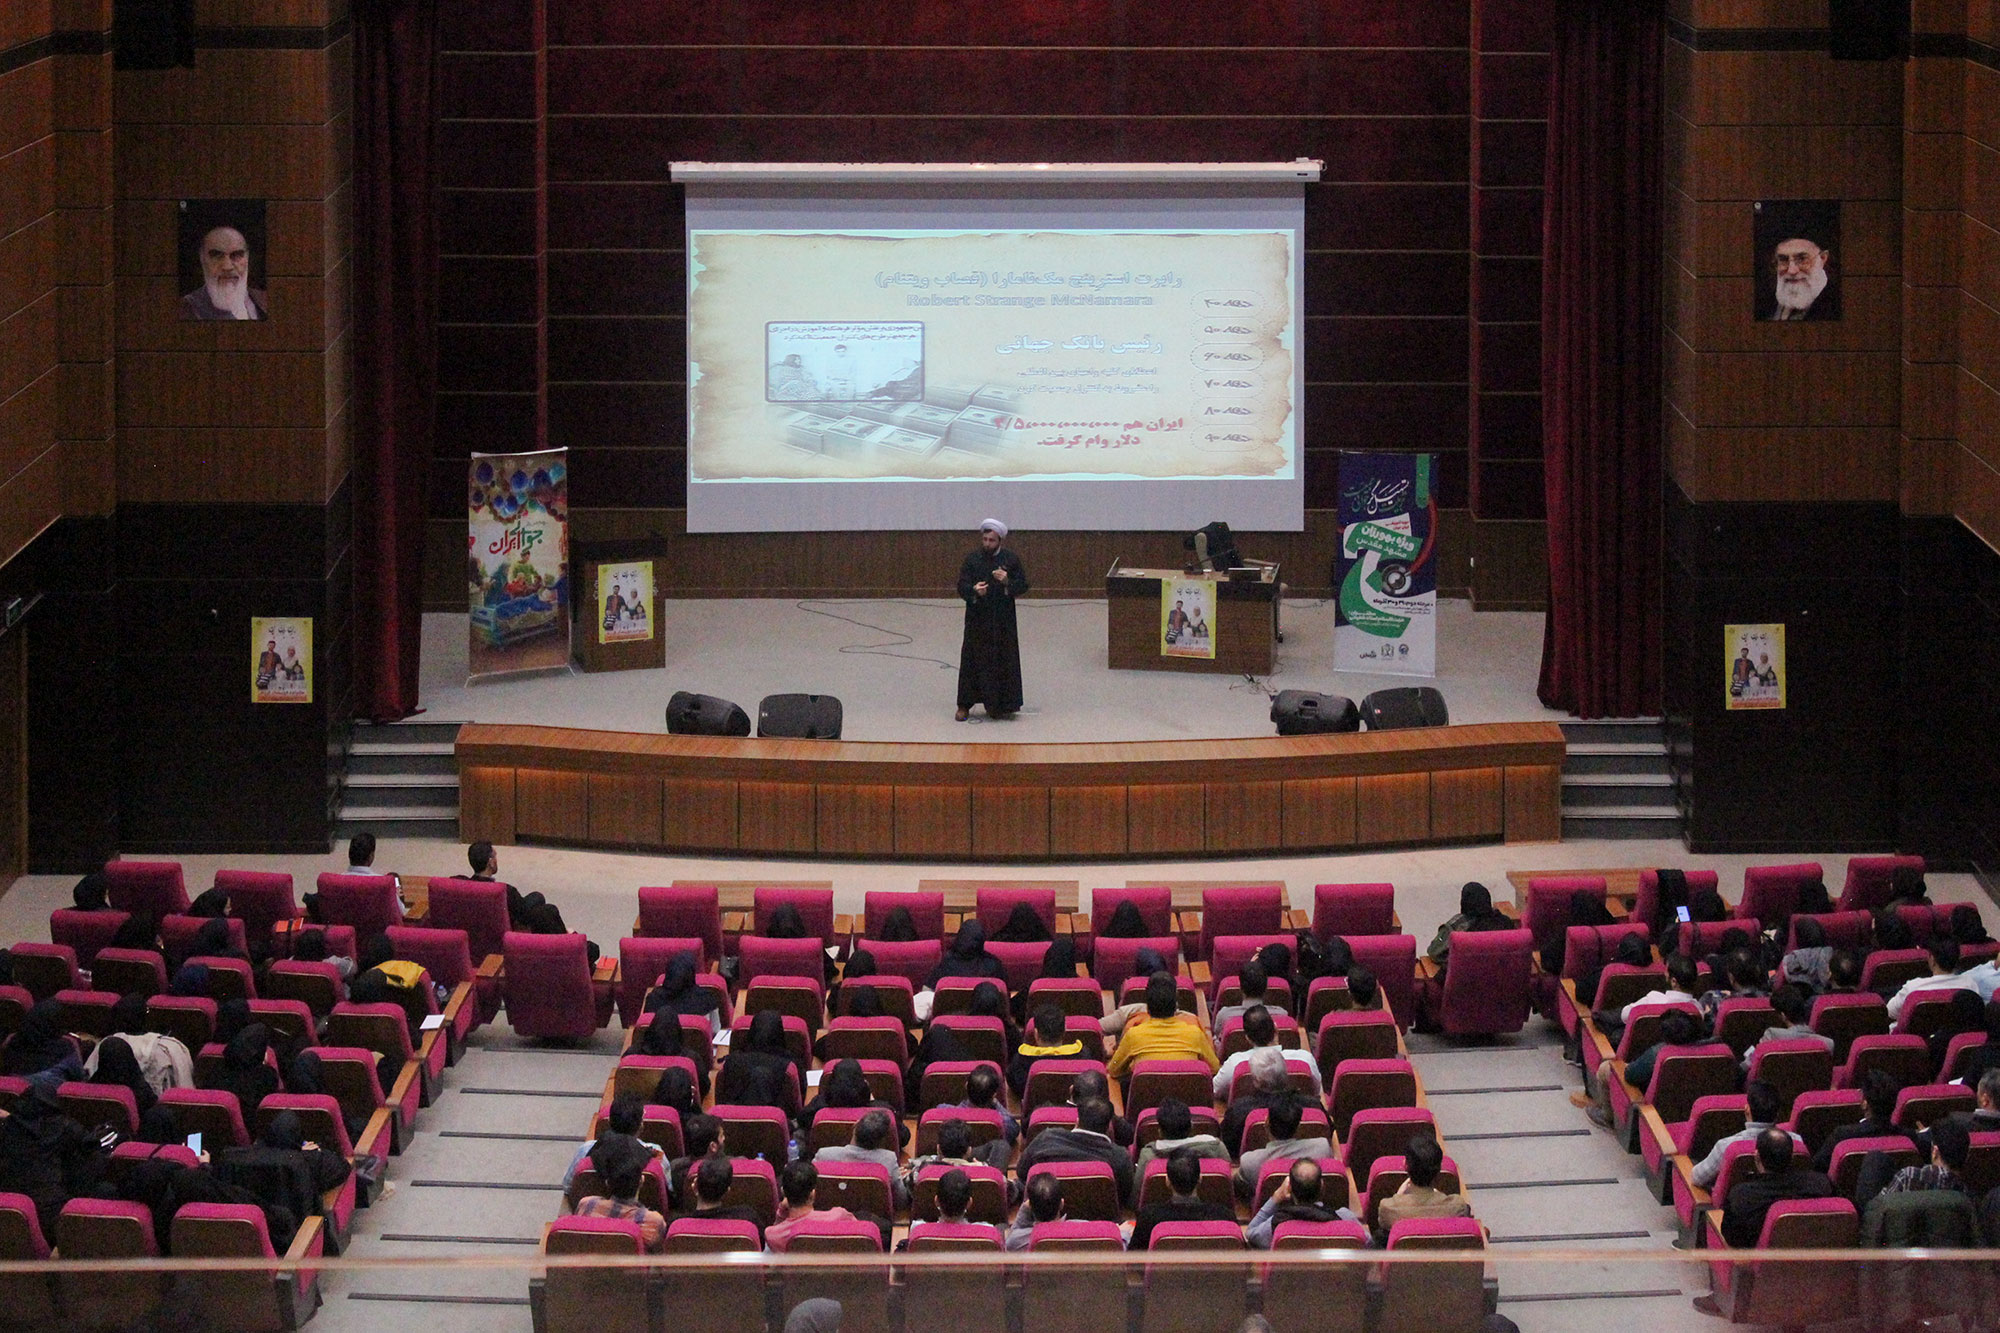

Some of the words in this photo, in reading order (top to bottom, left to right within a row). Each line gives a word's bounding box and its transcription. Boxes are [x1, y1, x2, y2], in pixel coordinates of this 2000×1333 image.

[906, 294, 970, 306] Robert
[974, 294, 1046, 308] Strange
[1051, 294, 1153, 306] McNamara
[995, 334, 1055, 355] جهانی
[1060, 334, 1105, 353] بانک
[1110, 333, 1163, 354] رئیس
[1123, 420, 1144, 431] هم
[1145, 417, 1183, 432] ایران
[1085, 434, 1109, 449] وام
[1112, 434, 1141, 449] دلار
[489, 529, 520, 556] ایران
[1356, 537, 1383, 550] مقدس
[1396, 534, 1415, 552] ویژه
[1383, 545, 1407, 558] مشهد
